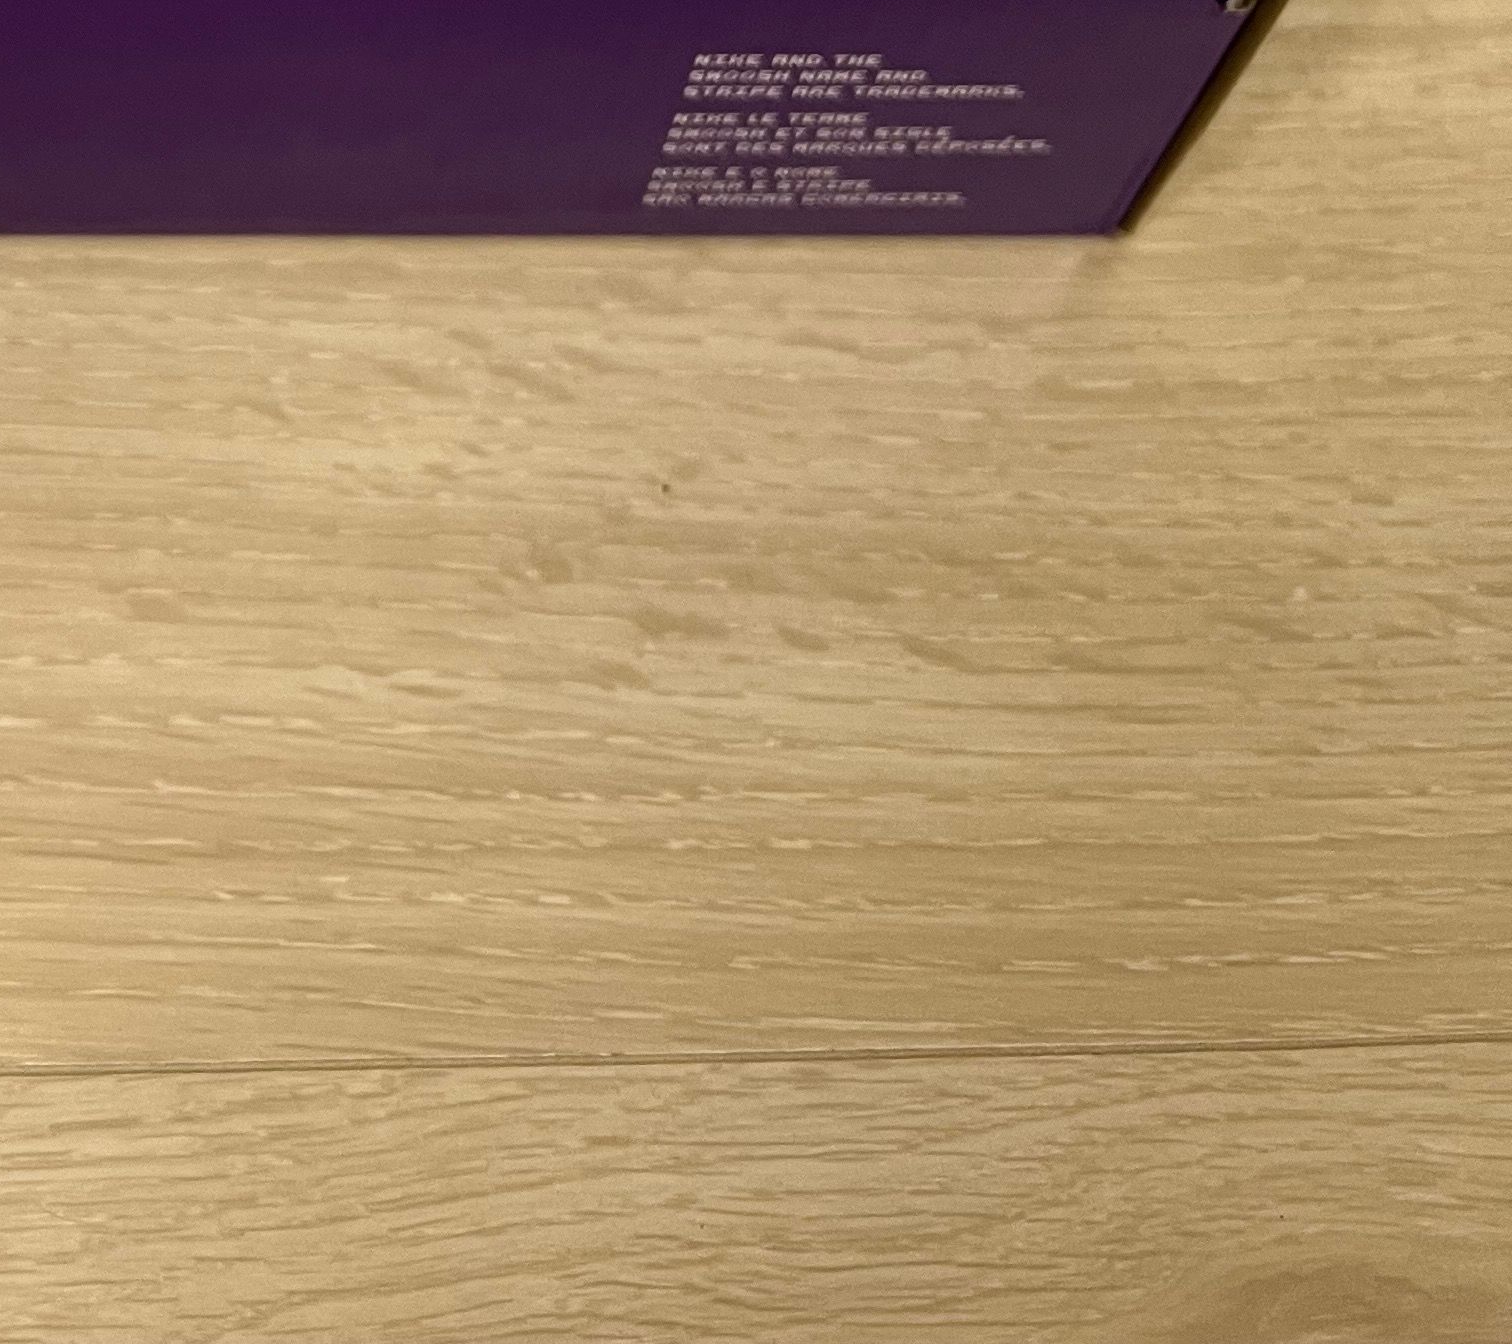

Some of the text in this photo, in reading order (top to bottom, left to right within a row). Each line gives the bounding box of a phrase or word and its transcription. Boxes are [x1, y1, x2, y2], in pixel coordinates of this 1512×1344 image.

[693, 53, 883, 68] NIKE AND THE
[688, 69, 928, 84] SWOOSH NAME AND
[682, 84, 785, 100] STRIPE
[791, 84, 845, 100] ARE
